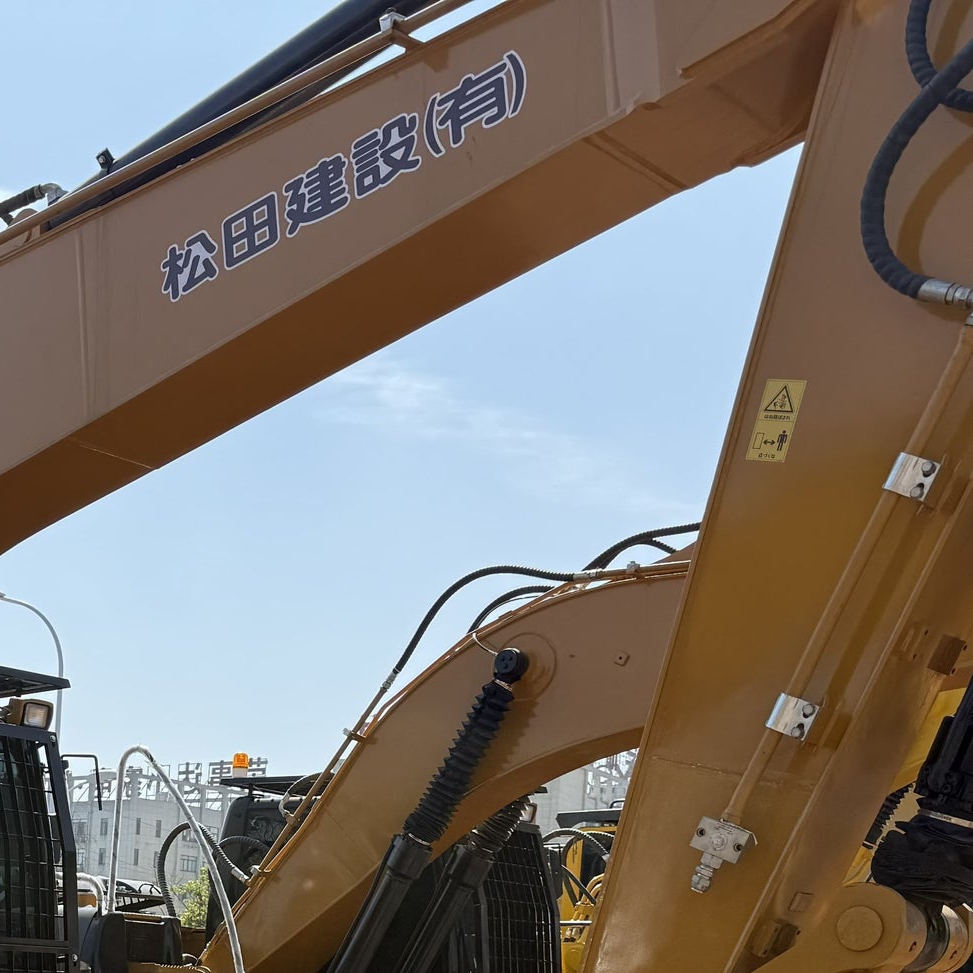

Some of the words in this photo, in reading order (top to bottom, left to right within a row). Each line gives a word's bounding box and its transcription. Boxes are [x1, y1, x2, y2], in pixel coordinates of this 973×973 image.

[160, 49, 527, 303] 松田建設(有)
